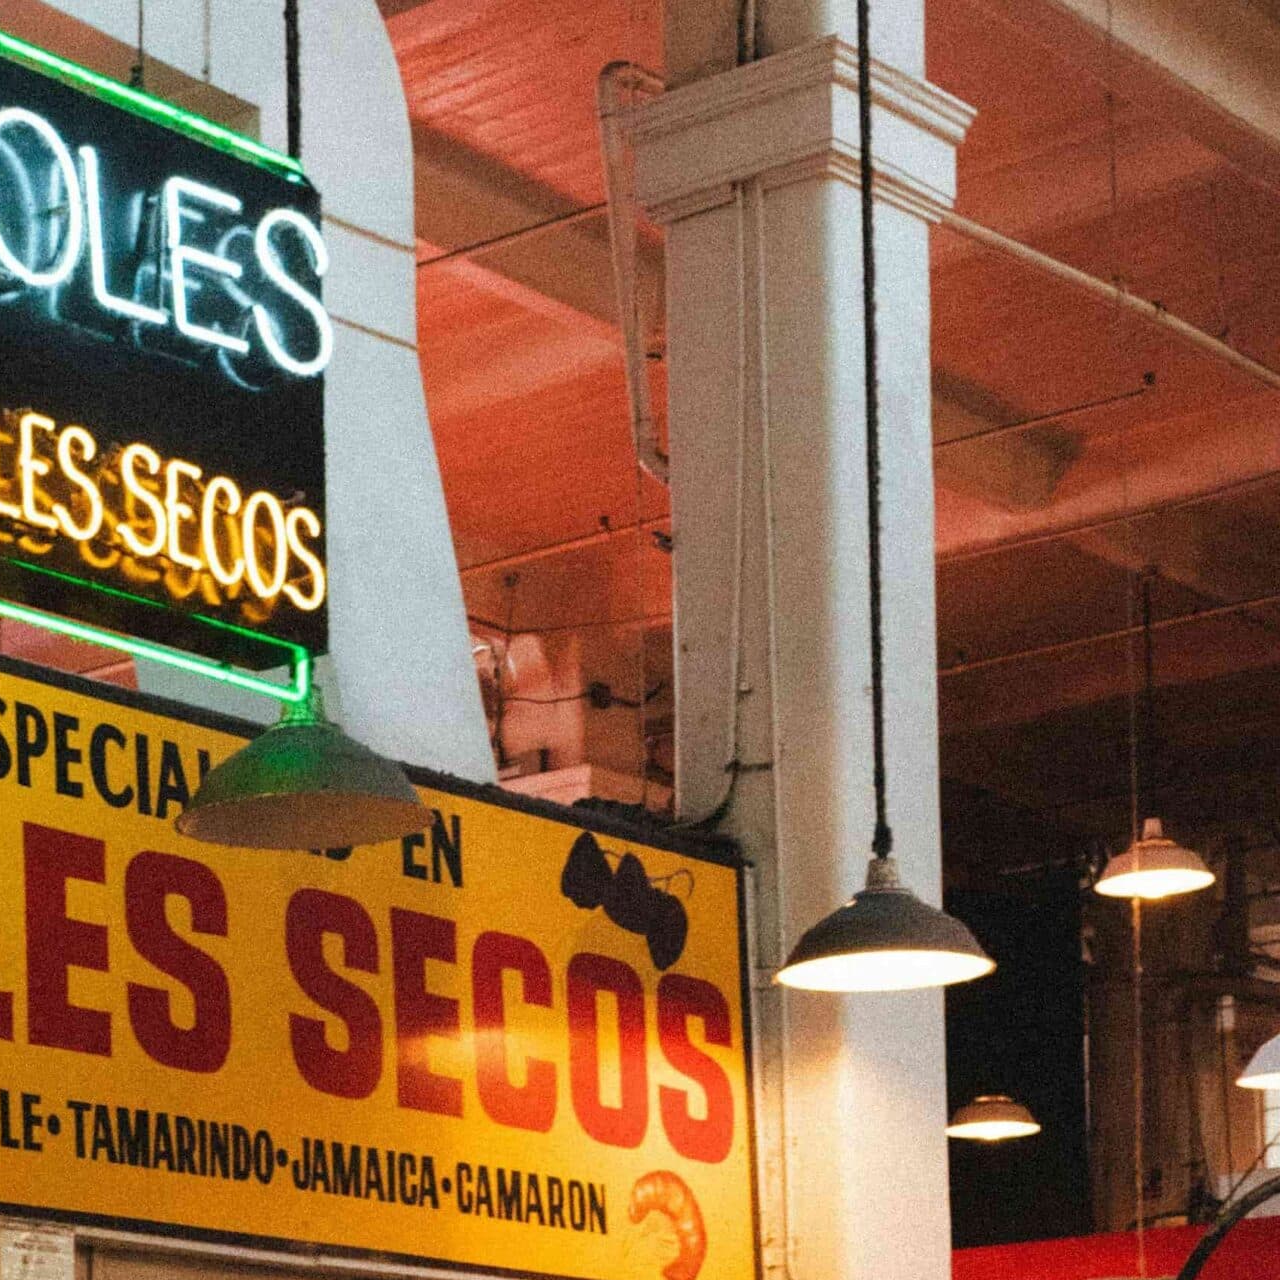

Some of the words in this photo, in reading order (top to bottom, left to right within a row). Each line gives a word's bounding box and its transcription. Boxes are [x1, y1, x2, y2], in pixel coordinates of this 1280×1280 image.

[116, 443, 326, 611] SECOS
[402, 810, 464, 888] EN
[285, 887, 735, 1166] SECOS
[67, 1101, 276, 1184] TAMARINDO
[292, 1136, 439, 1210] JAMAICA
[456, 1161, 608, 1234] CAMARON
